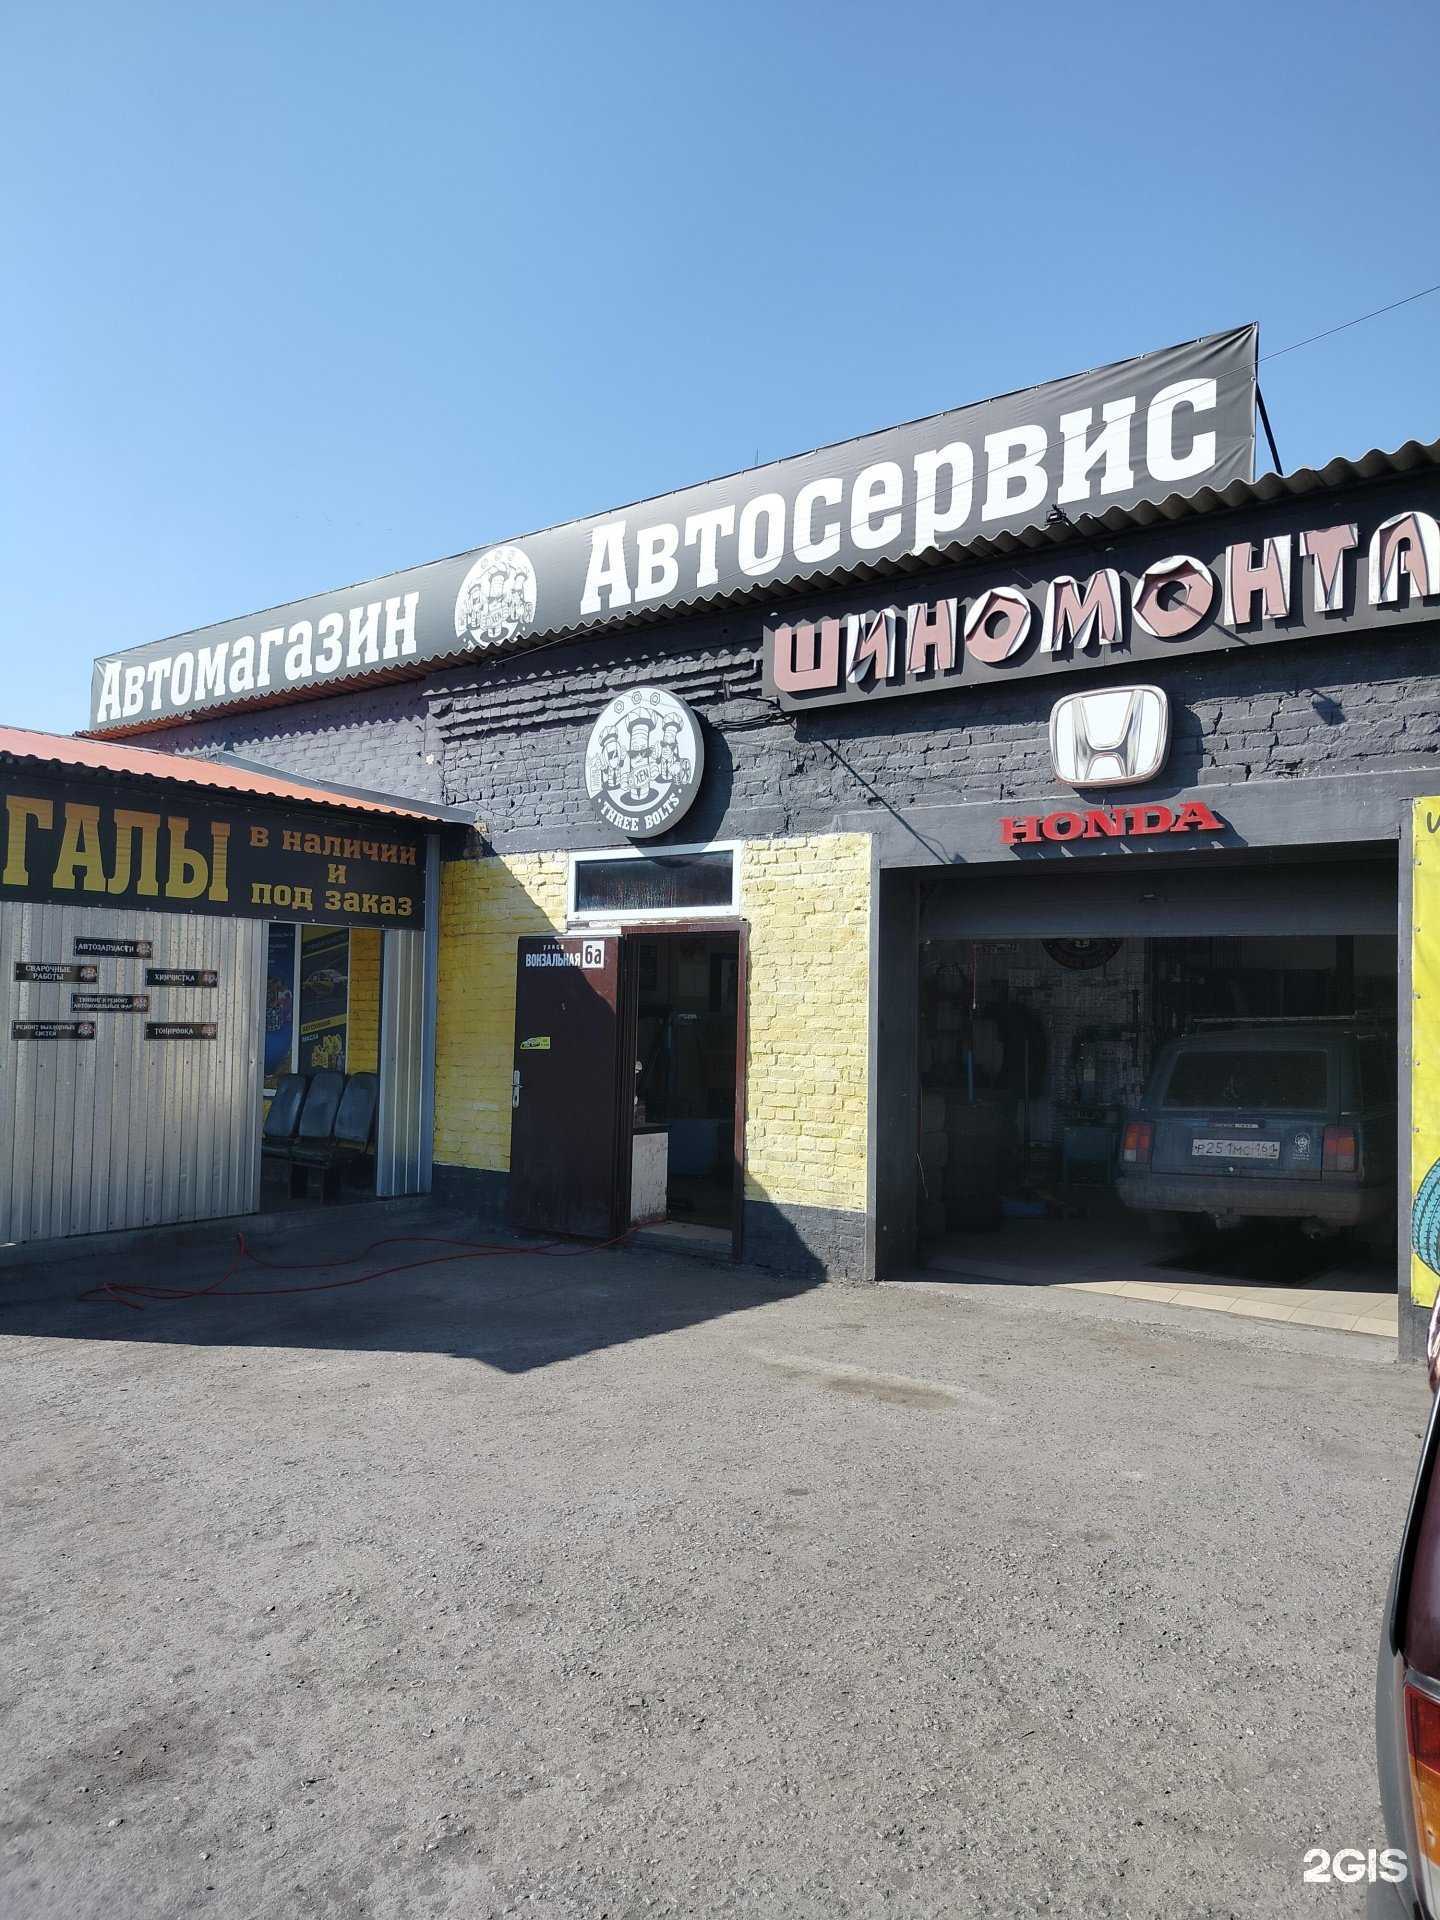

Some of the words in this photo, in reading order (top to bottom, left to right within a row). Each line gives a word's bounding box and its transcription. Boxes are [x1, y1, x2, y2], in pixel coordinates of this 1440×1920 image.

[580, 378, 1218, 615] Автосервис
[774, 511, 1440, 692] ШИНОМОНТА
[97, 592, 420, 722] Автомагазин
[600, 801, 640, 831] THREE
[644, 793, 680, 830] BOLTS
[1000, 801, 1225, 844] HONDA
[250, 826, 269, 847] в
[2, 795, 230, 902] ГАЛЫ
[327, 863, 347, 884] и
[251, 882, 313, 911] под
[324, 890, 413, 916] заказ
[77, 943, 134, 953] АВТОЗАПЧАСТИ
[25, 964, 72, 973] СВАРОЧНЫЕ
[525, 952, 581, 967] ВОКЗАЛЬНАЯ
[33, 972, 64, 981] РАБОТЫ
[154, 973, 195, 982] ХИМЧИСТКА
[154, 1027, 194, 1035] ТОНИРОВКА
